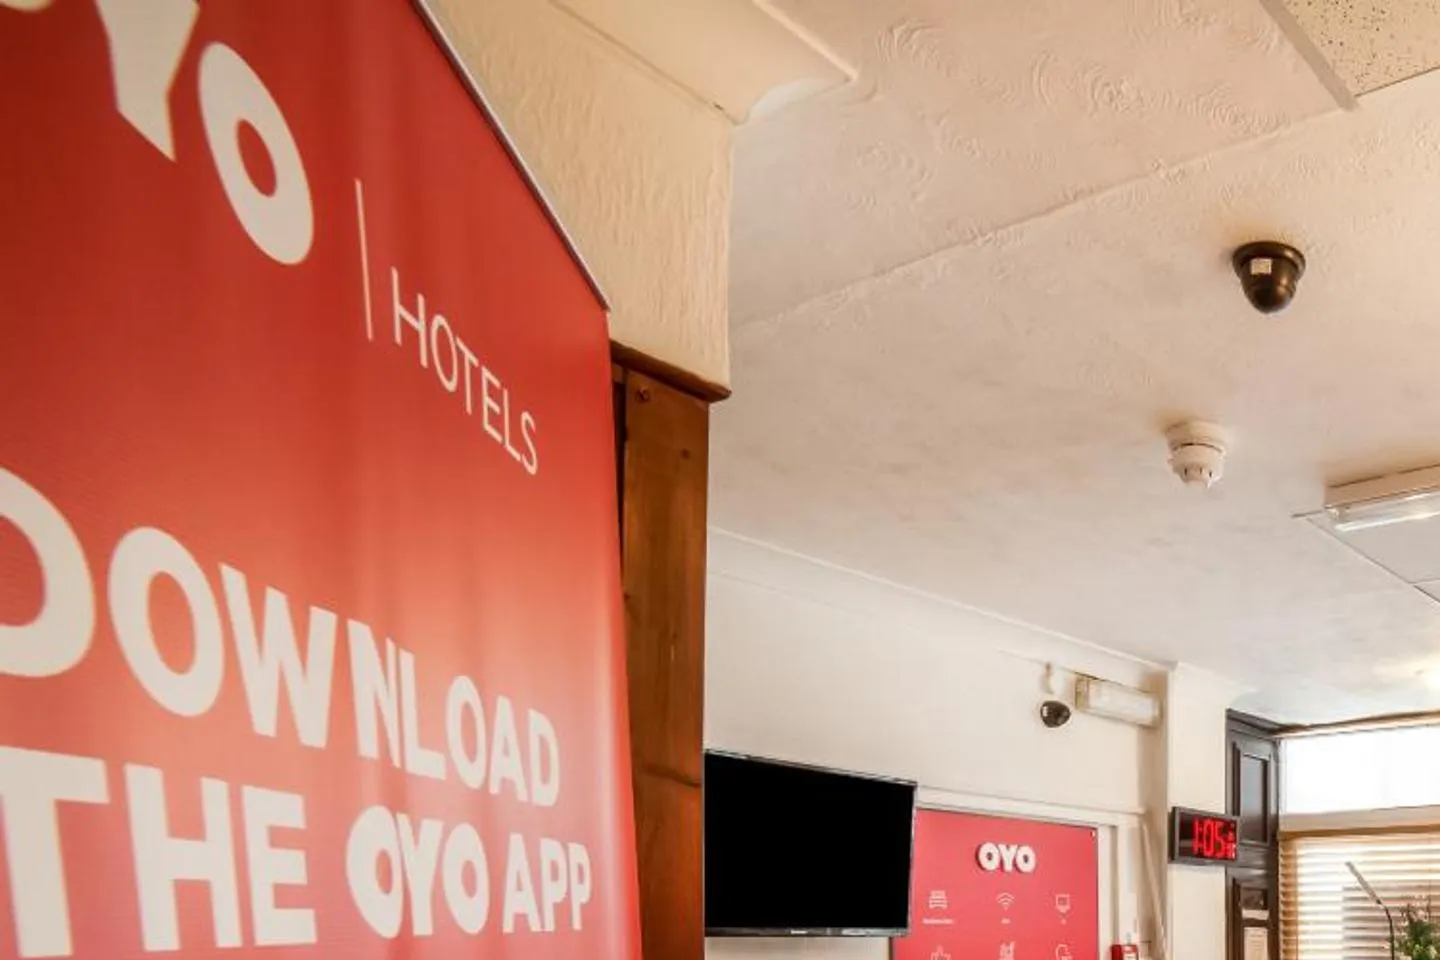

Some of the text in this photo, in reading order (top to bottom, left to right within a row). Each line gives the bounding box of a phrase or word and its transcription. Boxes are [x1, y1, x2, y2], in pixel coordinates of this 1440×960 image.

[0, 0, 314, 265] YO
[391, 266, 539, 475] HOTELS
[0, 745, 592, 958] THE OYO APP
[976, 842, 1037, 873] OYO
